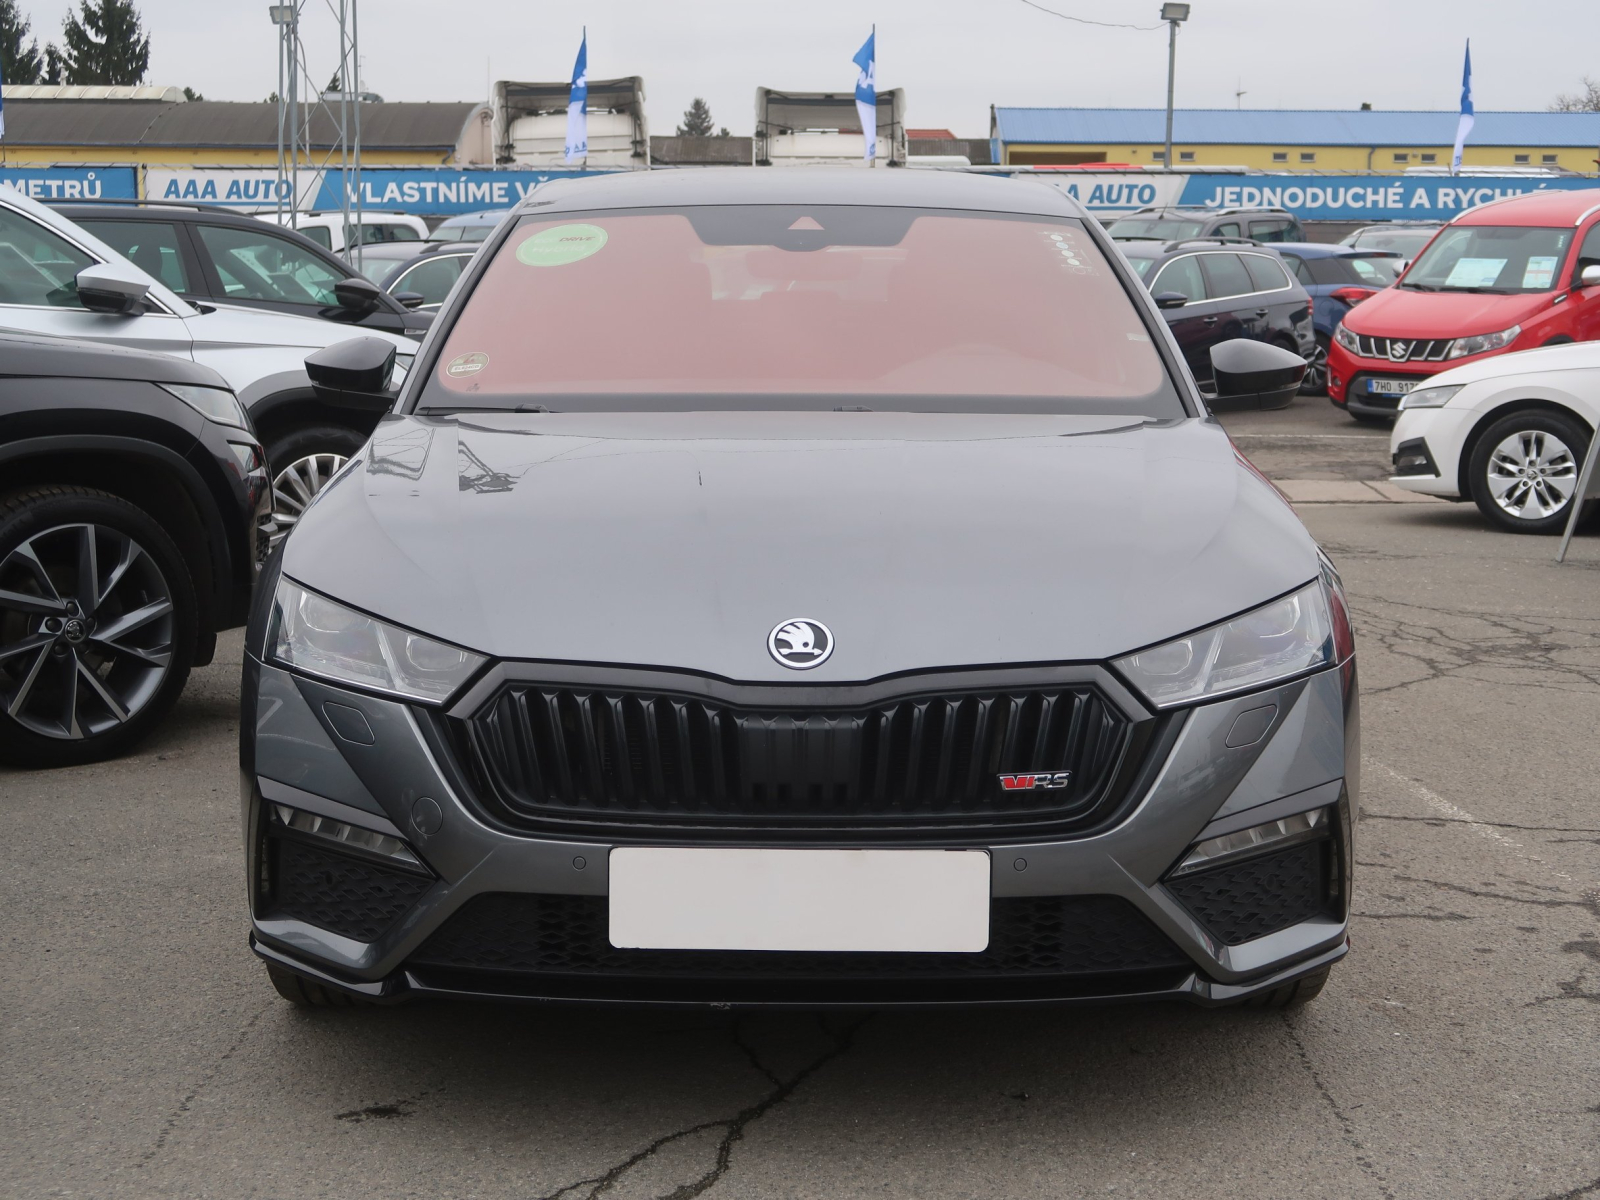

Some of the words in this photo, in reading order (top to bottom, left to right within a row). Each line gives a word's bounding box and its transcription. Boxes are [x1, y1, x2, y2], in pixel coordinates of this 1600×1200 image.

[3, 172, 102, 198] METRŮ
[163, 178, 218, 199] AAA
[225, 179, 293, 200] AUTO
[346, 176, 509, 203] VLASTNÍME
[1088, 183, 1157, 204] AUTO
[1205, 182, 1404, 209] JEDNODUCHÉ
[1409, 188, 1431, 209] A
